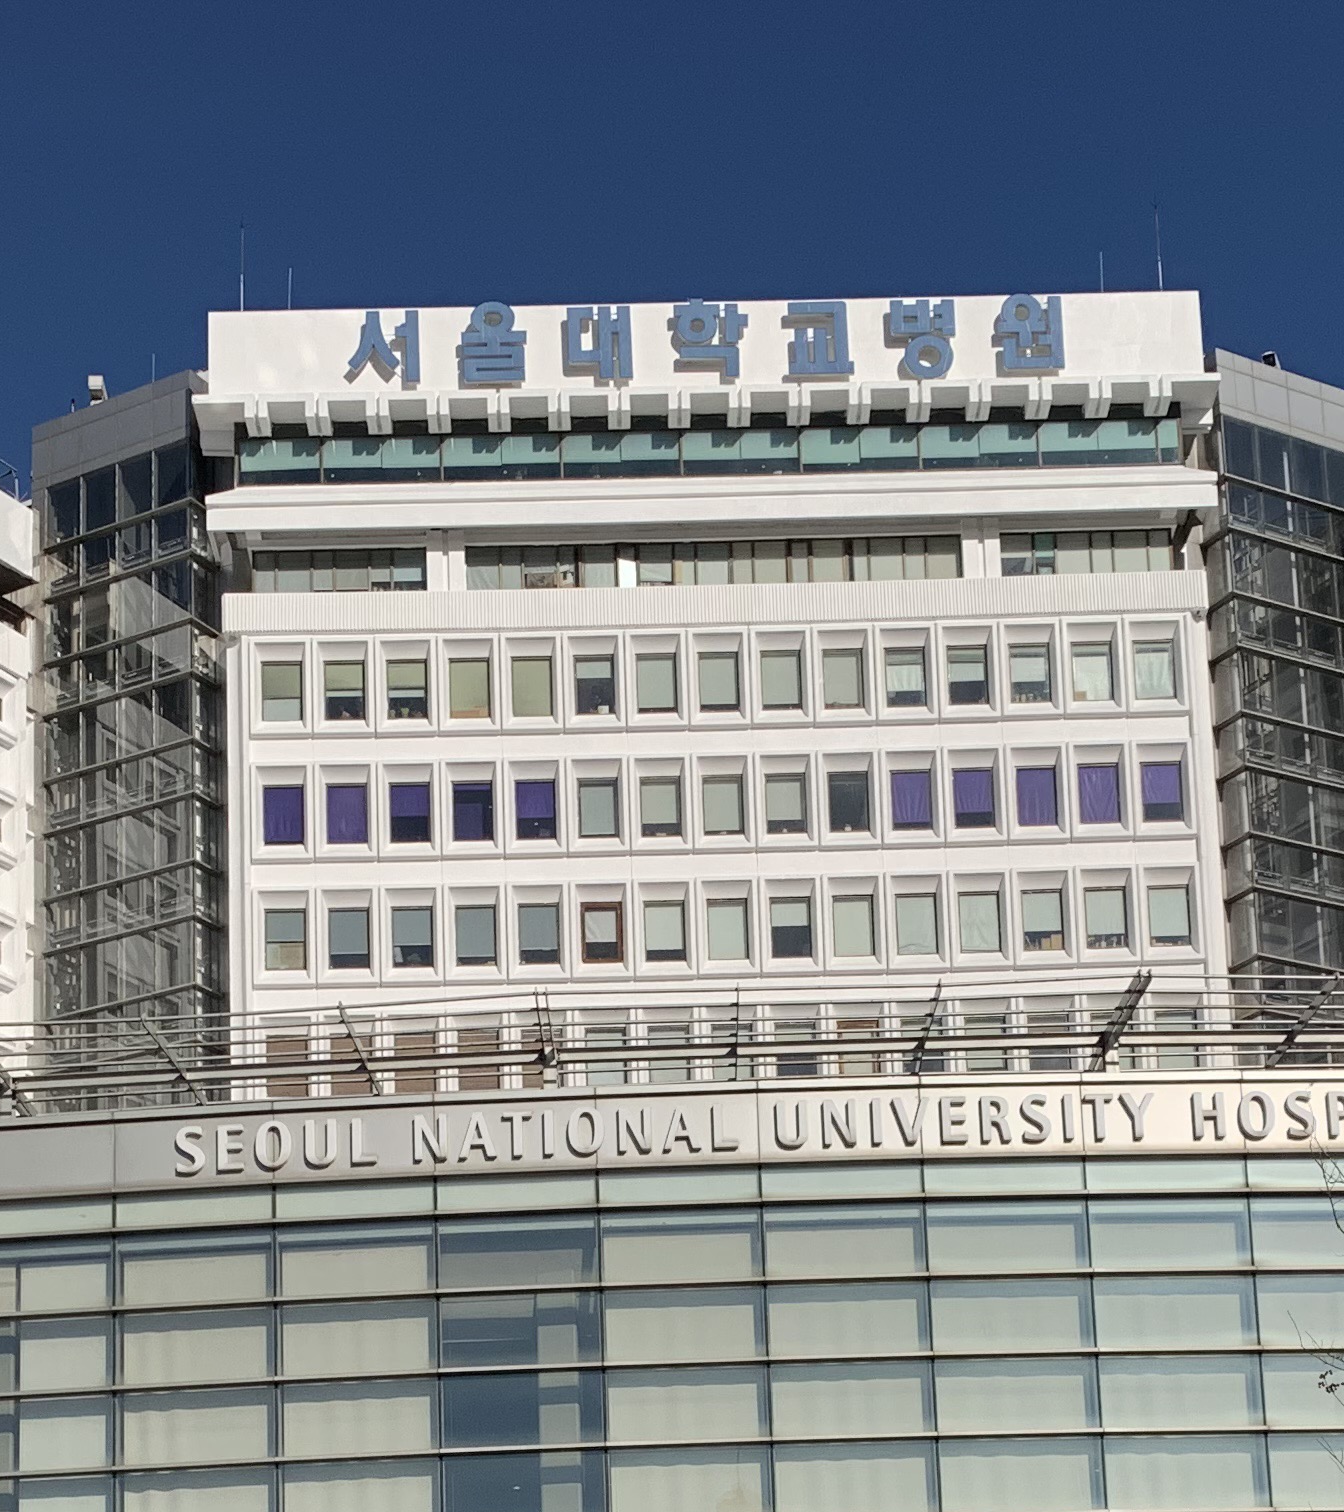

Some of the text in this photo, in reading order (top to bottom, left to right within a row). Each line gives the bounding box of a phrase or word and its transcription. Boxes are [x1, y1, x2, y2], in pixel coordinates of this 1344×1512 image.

[345, 293, 1066, 384] 서울대학교병원
[174, 1117, 378, 1177] SEOUL
[412, 1102, 740, 1164] NATIONAL
[772, 1090, 1154, 1151] UNIVERSITY
